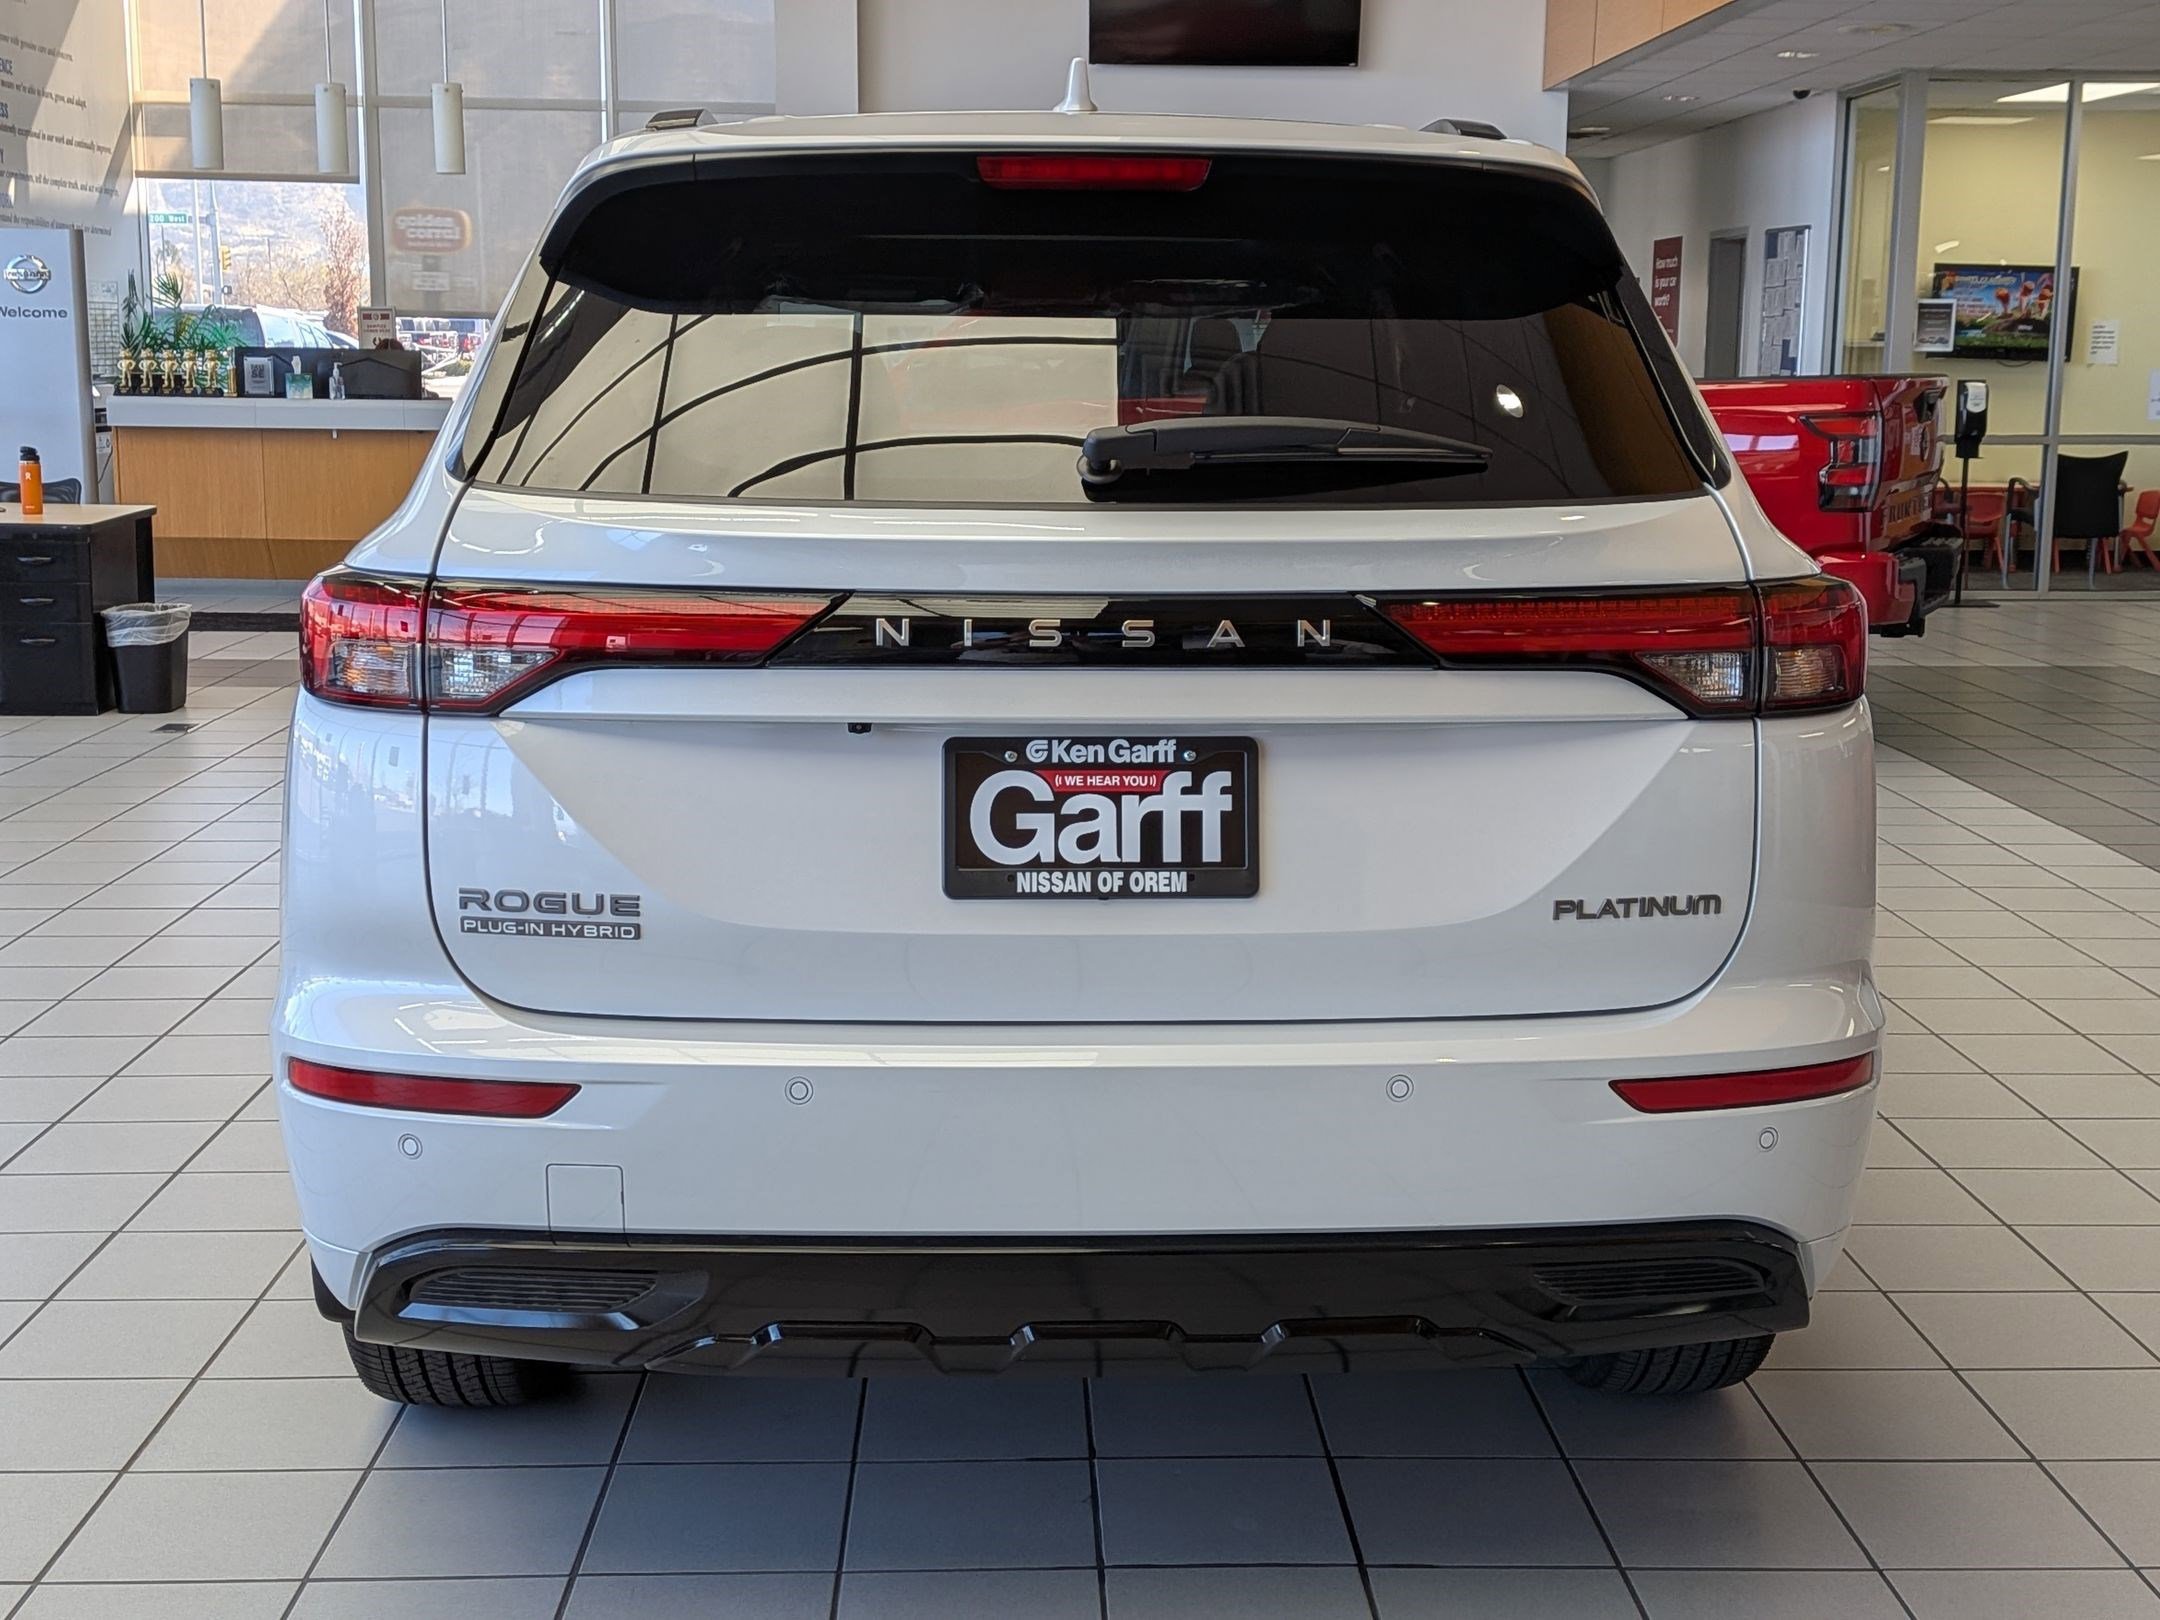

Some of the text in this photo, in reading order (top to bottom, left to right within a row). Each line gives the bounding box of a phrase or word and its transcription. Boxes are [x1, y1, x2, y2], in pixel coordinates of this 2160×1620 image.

[875, 618, 1331, 648] NISSAN
[1051, 738, 1177, 764] Ken Garff
[1064, 775, 1148, 787] WE HEAR YOU
[969, 769, 1233, 866] Garff
[1016, 871, 1188, 893] NISSAN OF OREM
[458, 887, 641, 917] ROGUE
[1552, 894, 1722, 921] PLATINUM
[463, 919, 636, 939] PLUG-IN HYBRID
